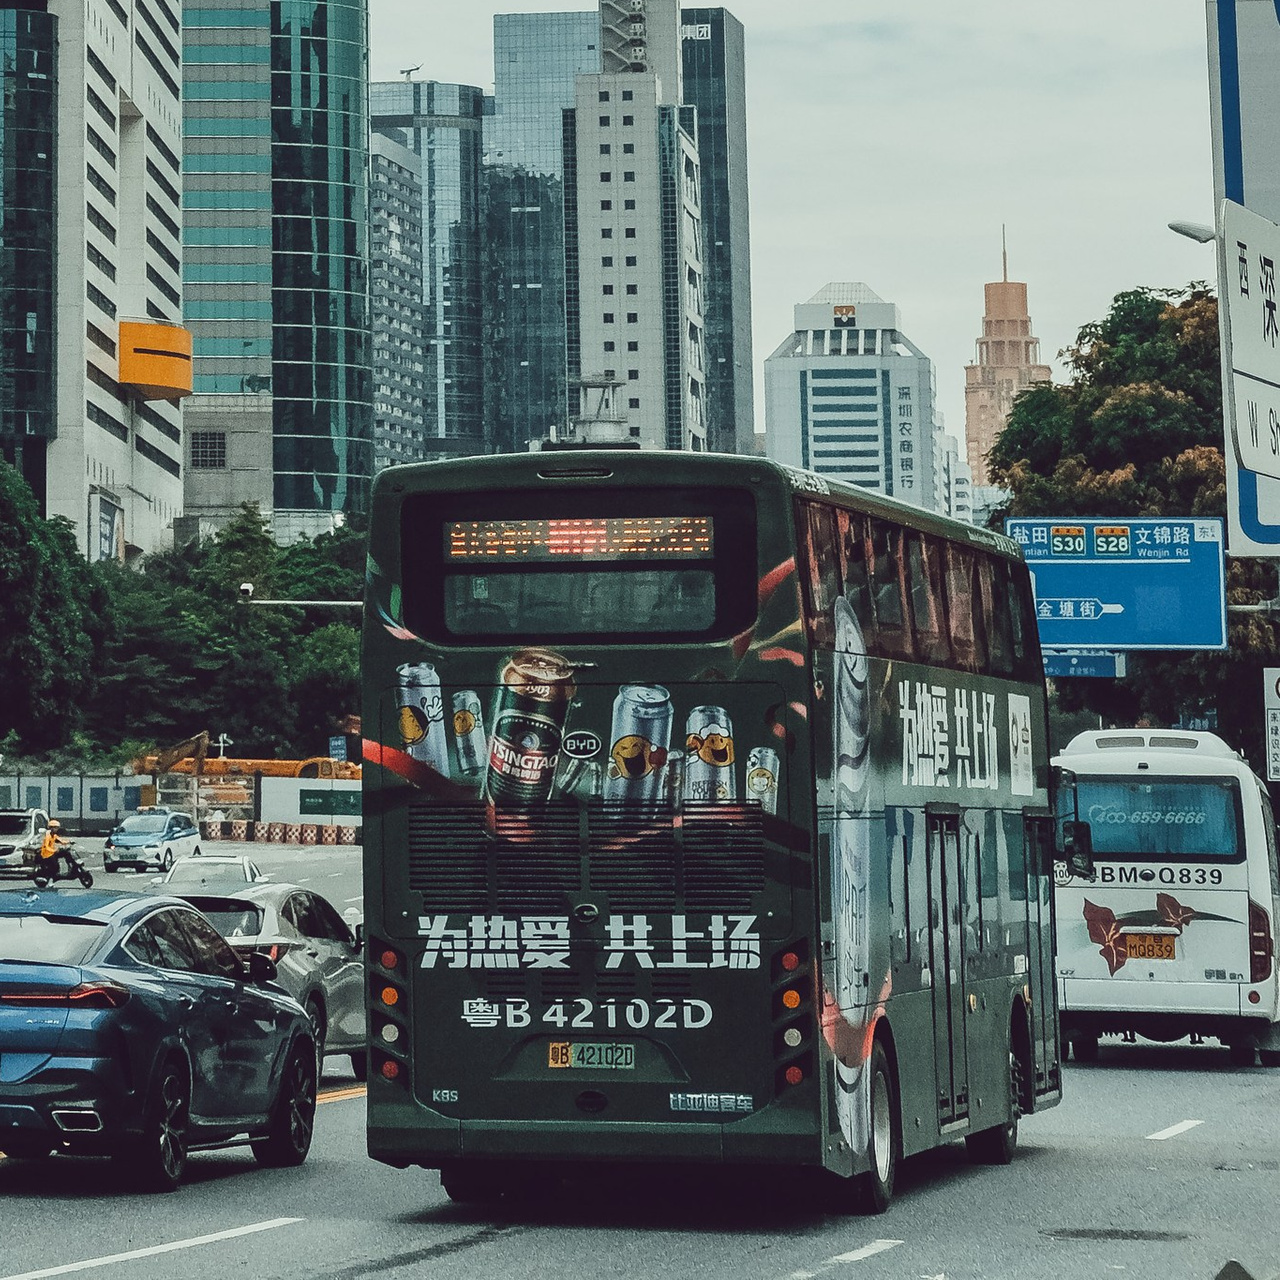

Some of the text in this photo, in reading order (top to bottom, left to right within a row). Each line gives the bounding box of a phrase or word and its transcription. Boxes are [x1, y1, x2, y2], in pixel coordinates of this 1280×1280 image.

[1237, 240, 1279, 349] 西 深
[898, 386, 914, 489] 深圳农商银行
[1247, 399, 1259, 449] W
[1013, 526, 1048, 545] 盐田
[1053, 536, 1084, 552] S30
[1096, 536, 1129, 552] S28
[1135, 525, 1191, 545] 文锦路
[1198, 525, 1210, 539] 东
[1025, 547, 1189, 558] ntian Wenjin Rd
[1038, 600, 1096, 618] 金塘街
[566, 738, 597, 751] BYD
[898, 679, 951, 788] 为热爱
[954, 687, 999, 790] 共上场
[493, 738, 559, 771] TSINGTAO
[1093, 866, 1138, 884] BM
[417, 915, 761, 969] 为热爱 共上场
[1128, 943, 1173, 959] MQ839
[461, 997, 713, 1028] 粤B 42102D
[551, 1045, 633, 1066] 粤B 42102D
[669, 1092, 754, 1113] 比亚迪客车
